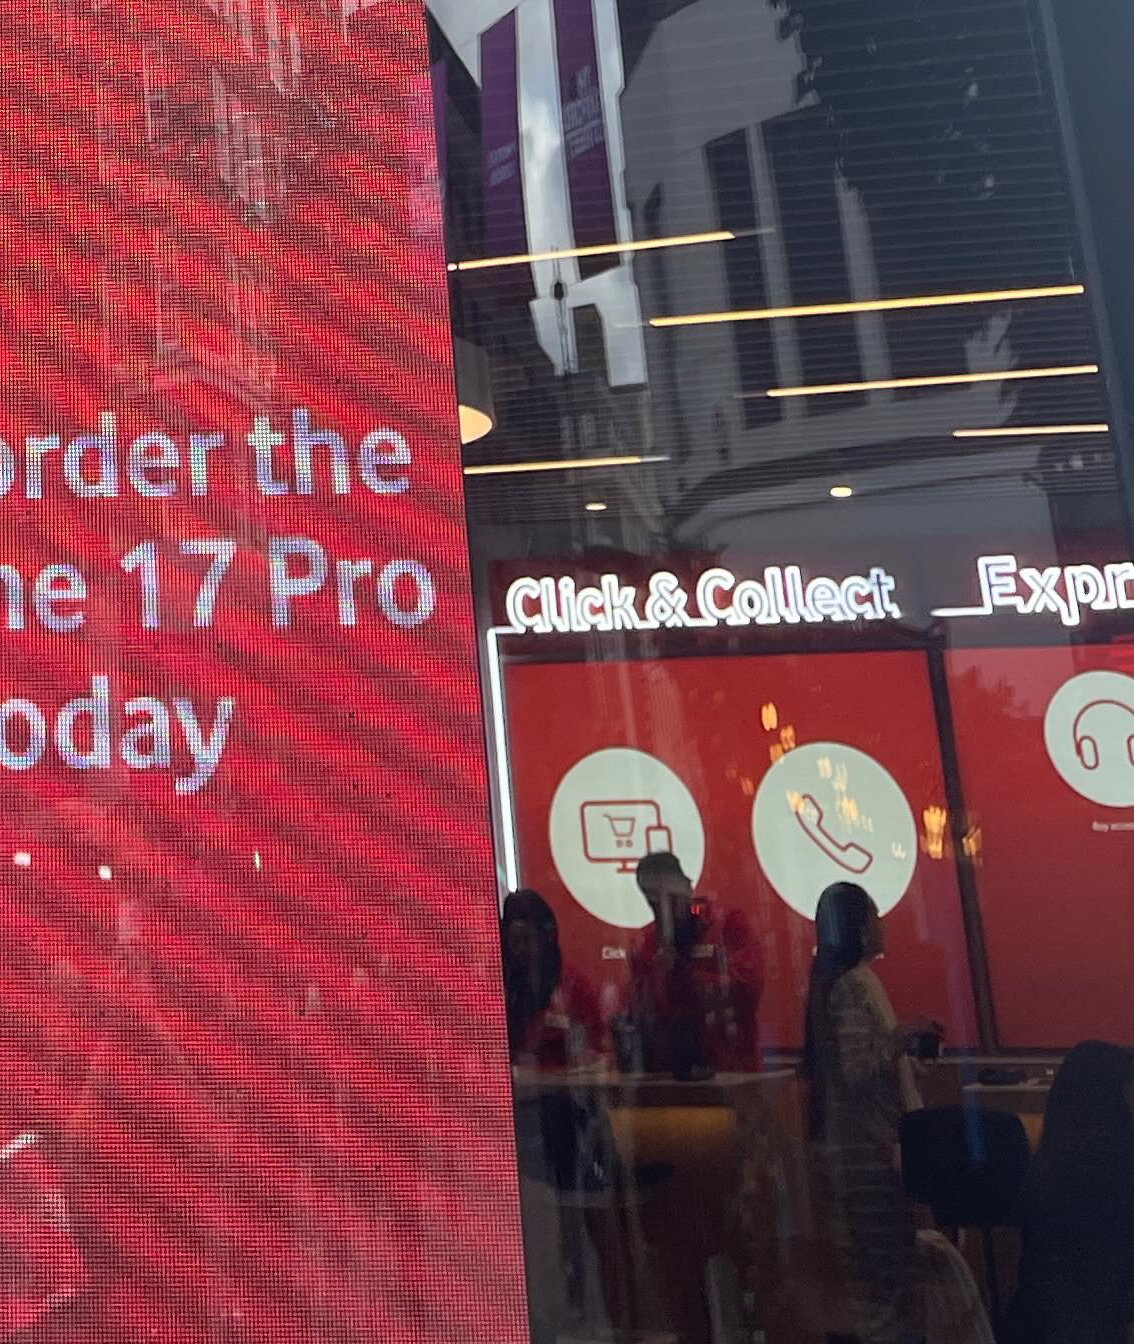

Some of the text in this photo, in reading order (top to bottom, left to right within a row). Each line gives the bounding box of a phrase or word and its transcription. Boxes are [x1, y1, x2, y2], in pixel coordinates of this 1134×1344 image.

[246, 409, 413, 496] the
[120, 540, 237, 631] 17
[270, 535, 437, 628] Pro
[977, 555, 1134, 626] Expr
